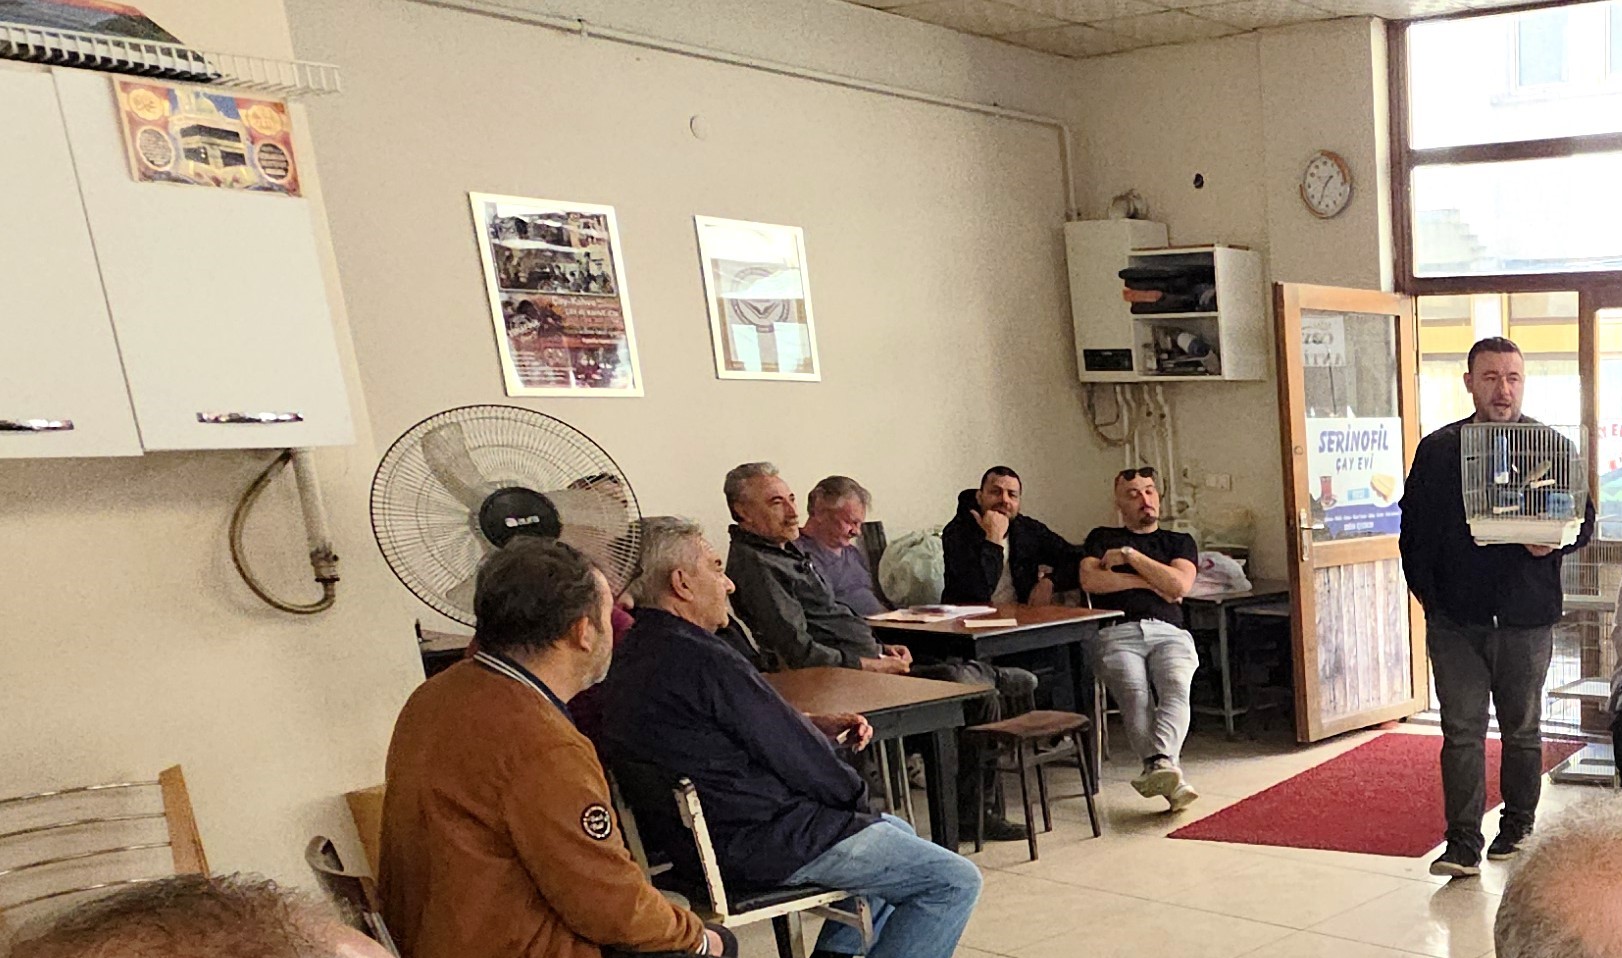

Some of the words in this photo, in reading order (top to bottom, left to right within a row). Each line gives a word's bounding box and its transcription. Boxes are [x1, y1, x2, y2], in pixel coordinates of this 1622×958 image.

[1318, 424, 1389, 454] SERİNOFİL
[1336, 457, 1355, 474] ÇAY
[1357, 454, 1374, 471] EVİ
